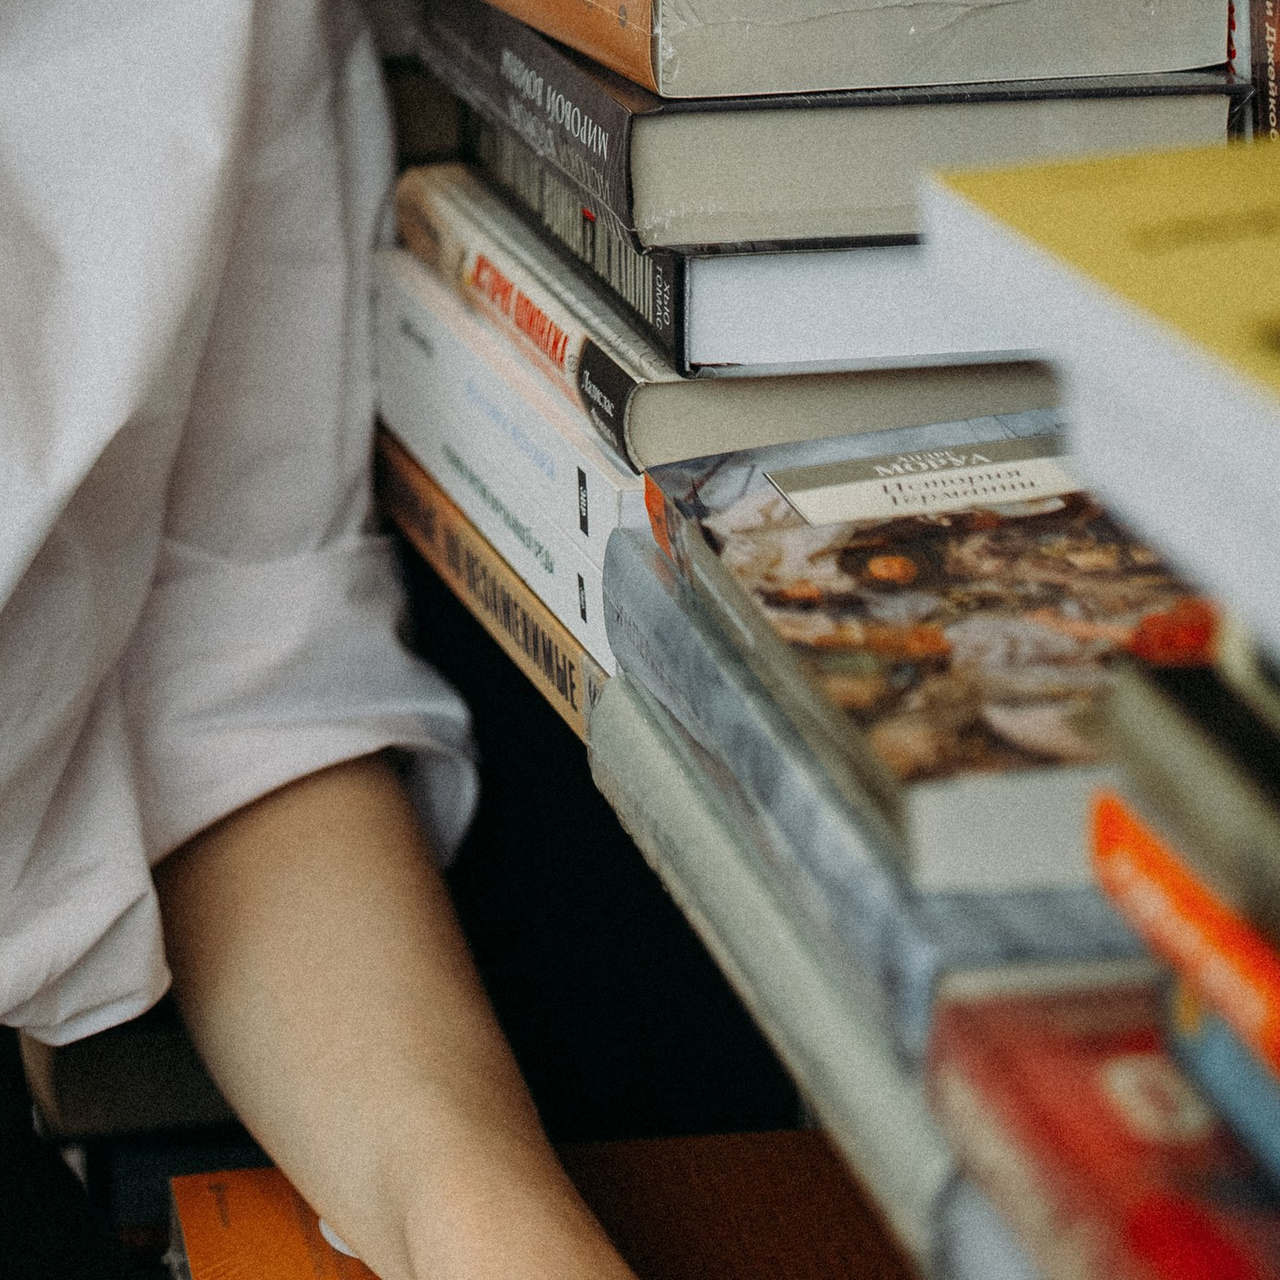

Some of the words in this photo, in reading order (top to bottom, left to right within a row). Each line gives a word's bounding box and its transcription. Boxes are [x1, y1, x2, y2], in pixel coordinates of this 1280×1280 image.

[1264, 23, 1279, 141] Джейкоб
[546, 85, 609, 162] МИРОВОЙ
[655, 265, 663, 331] ТОМАС
[663, 280, 671, 326] ХЬЮ
[872, 451, 993, 477] МОРУА
